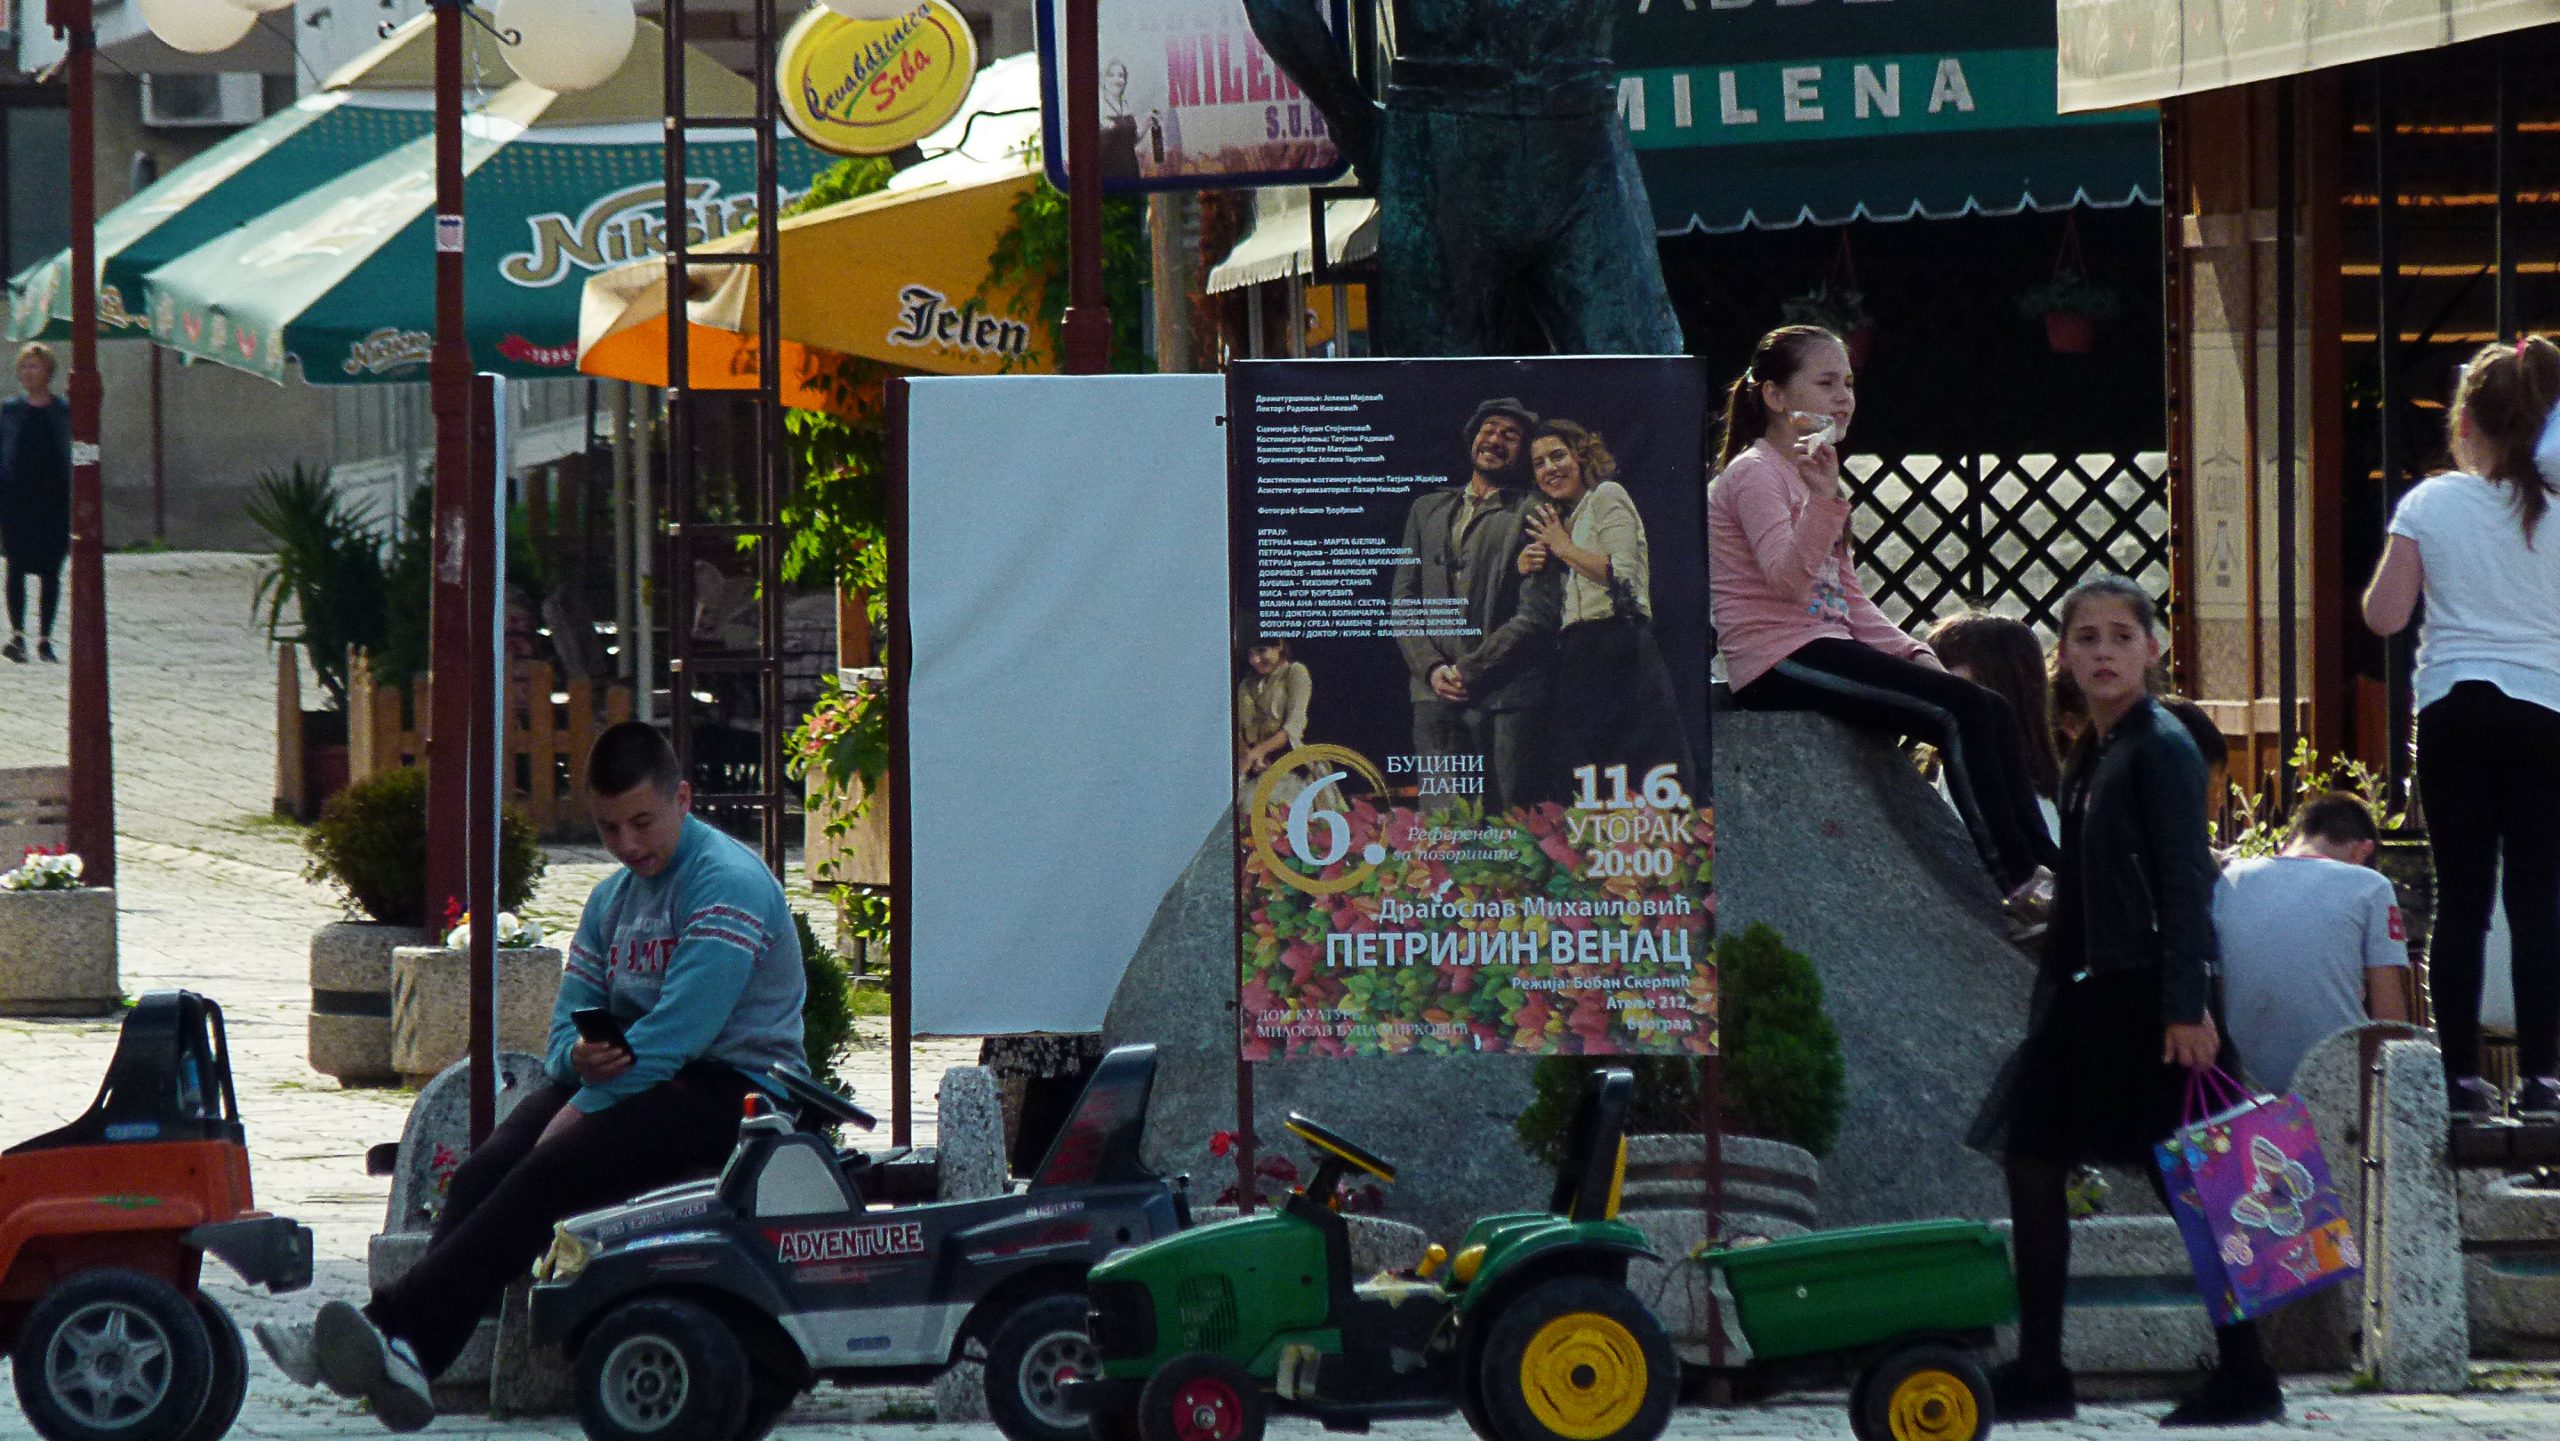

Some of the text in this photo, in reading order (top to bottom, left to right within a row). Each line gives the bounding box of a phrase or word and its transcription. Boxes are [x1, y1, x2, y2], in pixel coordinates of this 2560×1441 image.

[868, 48, 931, 112] Srba
[1616, 58, 1976, 131] MILENA
[887, 284, 1030, 358] Jelen
[1258, 549, 1291, 557] ПЕТРИЈА
[1324, 538, 1350, 546] МАРТА
[1258, 559, 1291, 567] ПЕТРИЈА
[1387, 754, 1484, 774] БУЦИНИ
[1418, 776, 1485, 796] ДАНИ
[1573, 764, 1691, 810] 11.6.
[1286, 771, 1386, 867] 6.
[1407, 825, 1518, 845] Референдум
[1567, 813, 1694, 845] УТОРАК
[1586, 847, 1674, 879] 20:00
[1377, 896, 1691, 923] Драгослав Михаиловић
[1326, 929, 1692, 970] ПЕТРИЈИН ВЕНАЦ
[1512, 974, 1690, 992] Режија: Бобан Скерлић
[778, 1222, 924, 1263] ADVENTURE
